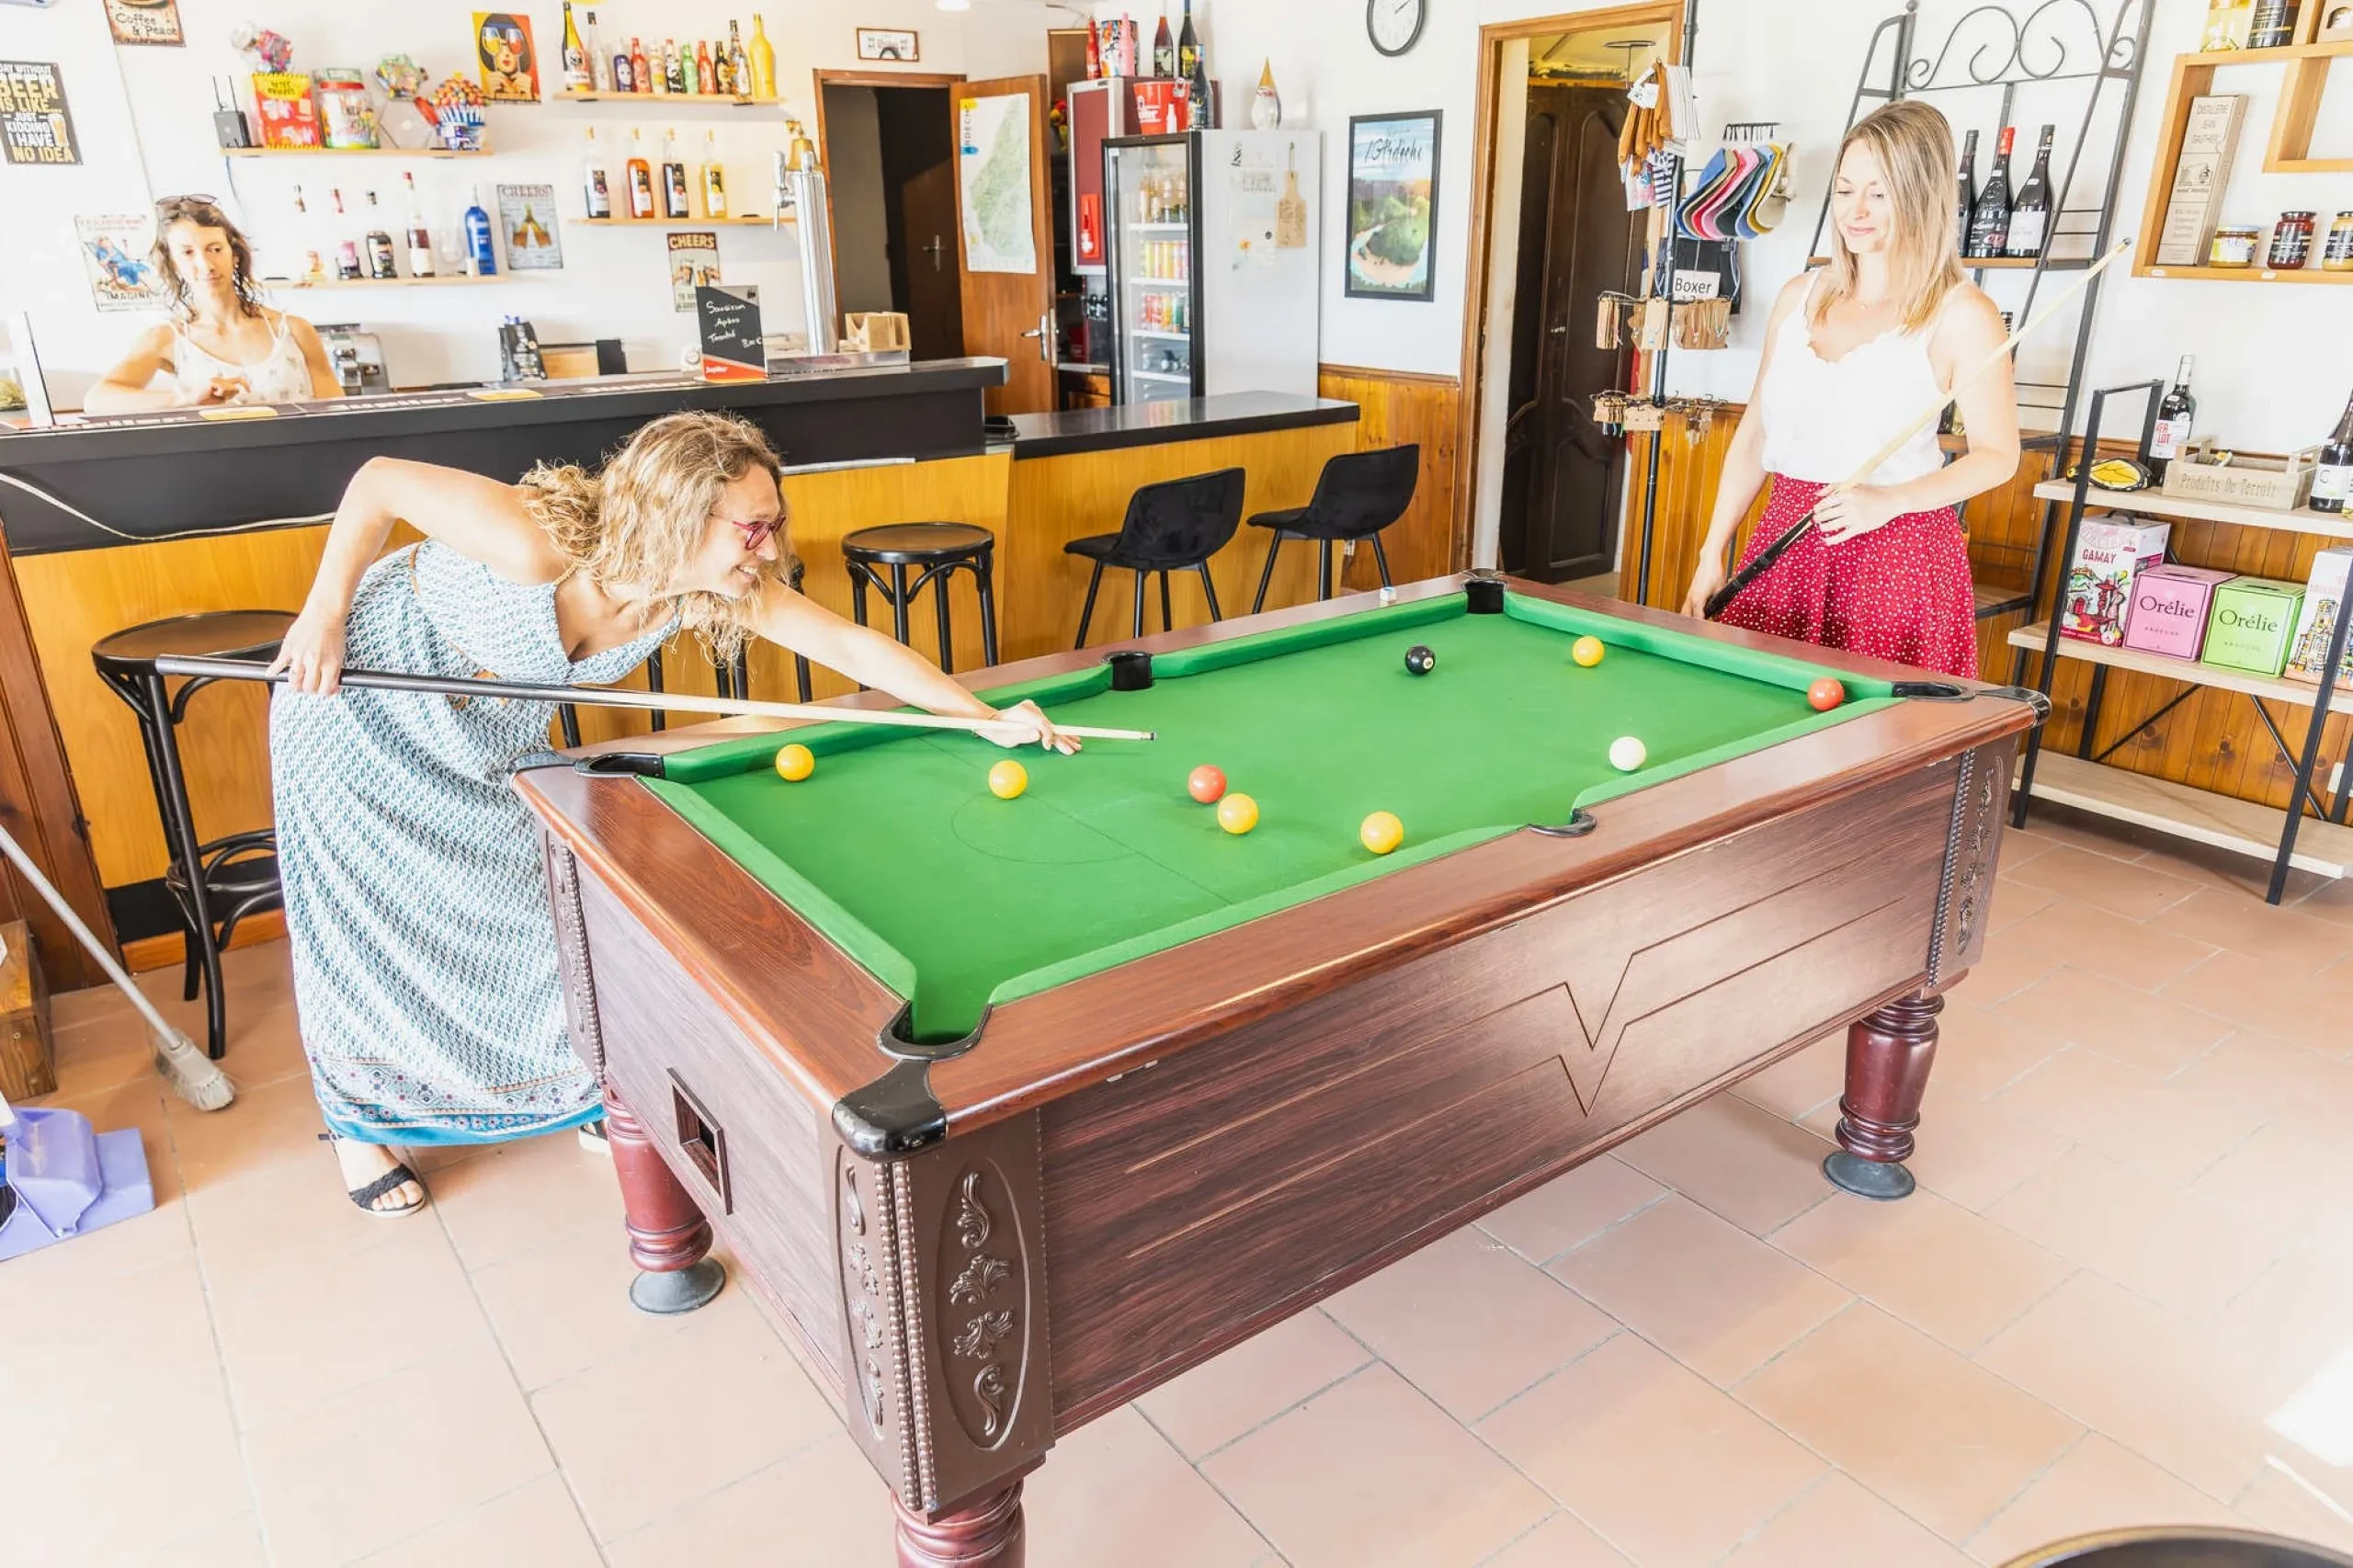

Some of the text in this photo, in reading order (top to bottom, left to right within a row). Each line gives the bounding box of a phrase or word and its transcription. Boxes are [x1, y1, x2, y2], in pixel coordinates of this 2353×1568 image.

[116, 12, 156, 26] Coffee
[145, 25, 178, 37] Peace
[5, 121, 51, 133] KIDDING
[8, 132, 54, 147] I HAVE
[11, 146, 76, 163] NO IDEA
[669, 234, 715, 248] CHEERS
[1675, 278, 1712, 294] Boxer
[2180, 473, 2221, 493] Produits
[2242, 478, 2276, 497] Terroir
[2082, 549, 2118, 563] GAMAY
[2140, 596, 2195, 618] Orélie
[2220, 608, 2278, 632] Orélie
